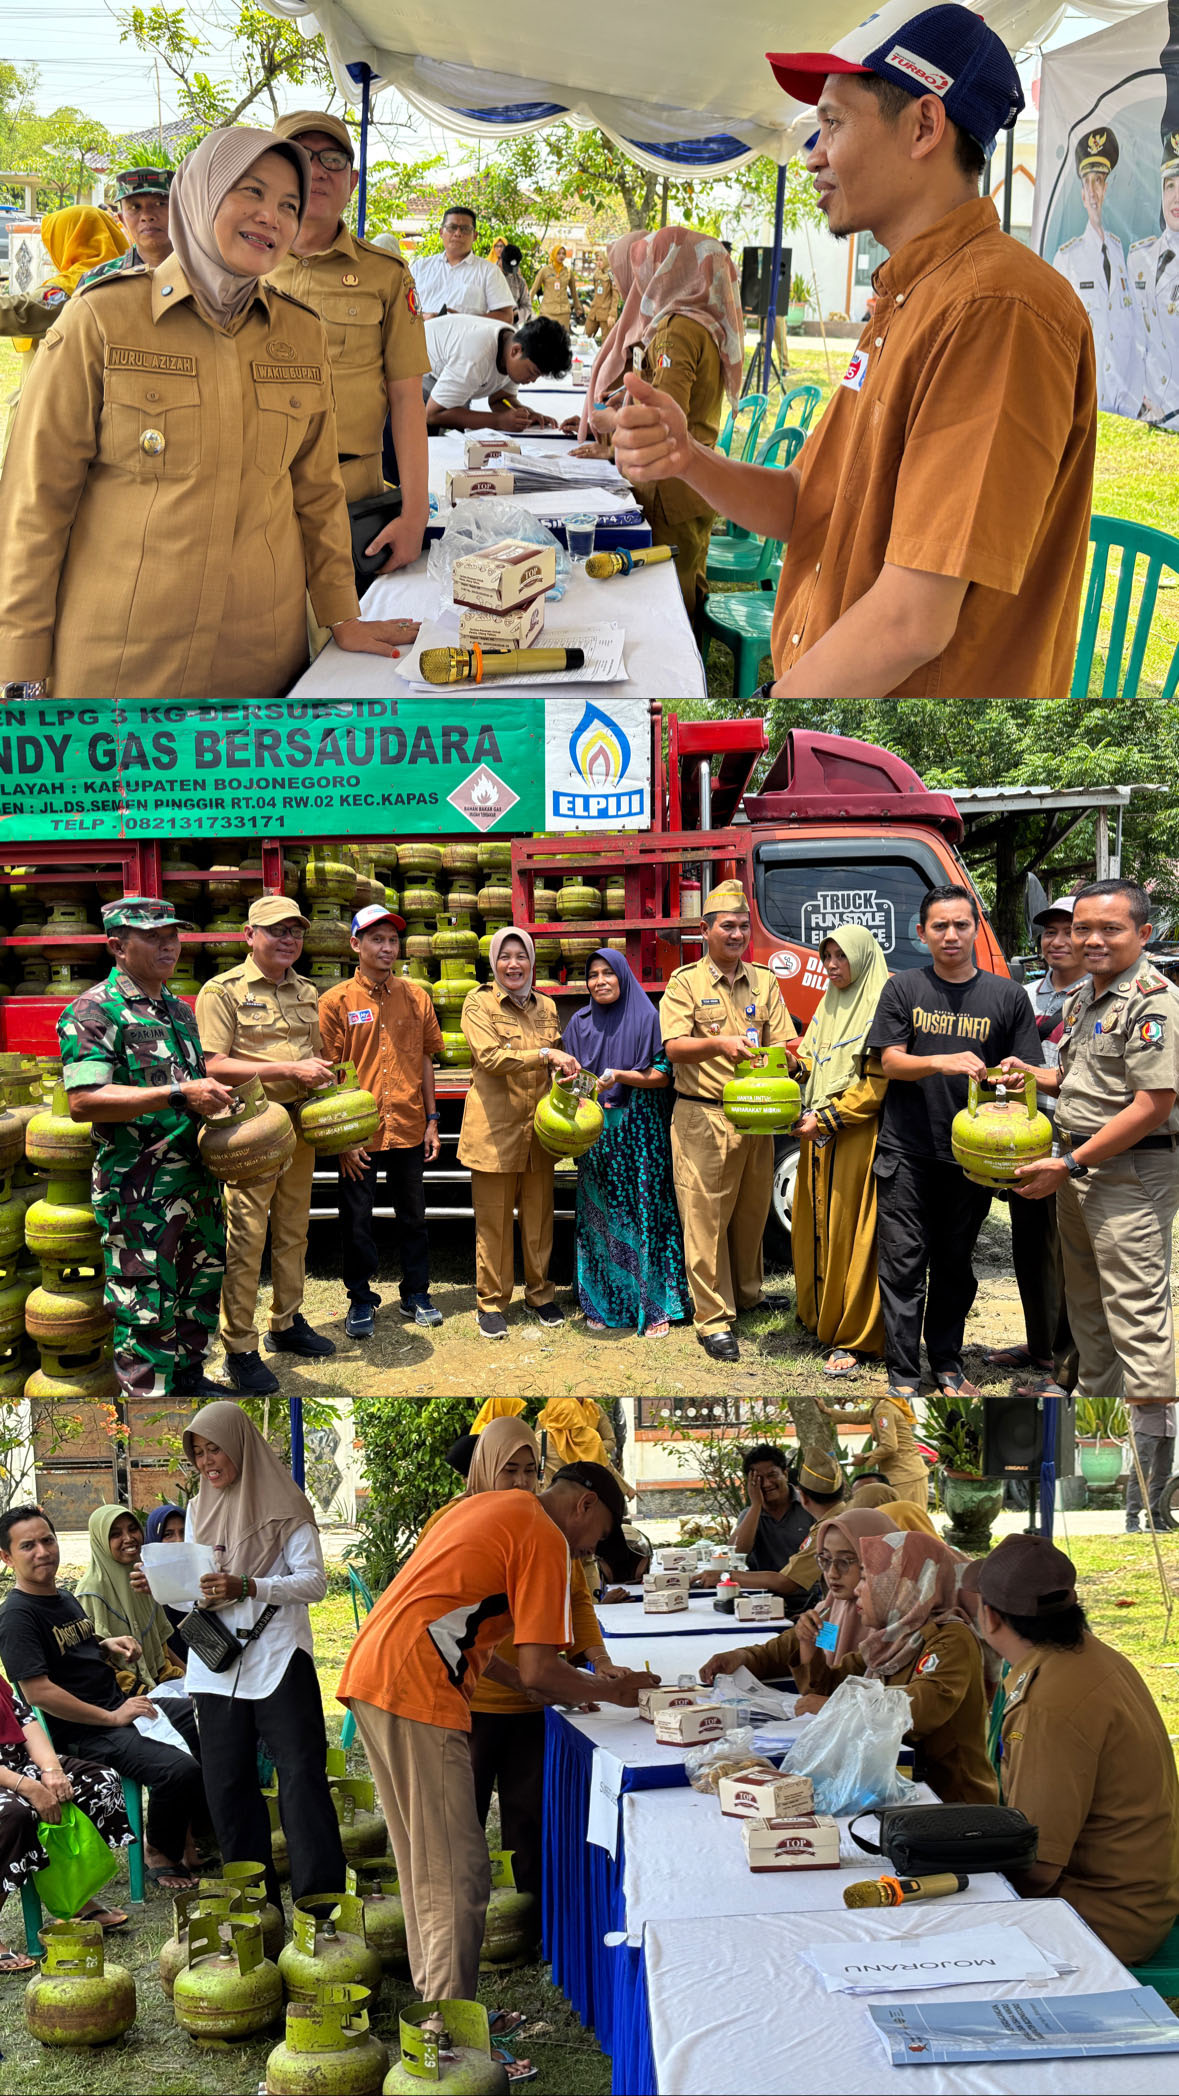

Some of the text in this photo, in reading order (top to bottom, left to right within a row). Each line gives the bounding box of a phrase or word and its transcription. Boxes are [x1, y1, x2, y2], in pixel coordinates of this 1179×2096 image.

[890, 55, 937, 85] TURBO
[111, 350, 192, 372] NURUL AZIZAH
[257, 366, 320, 380] WAKIL BUPATI
[38, 709, 99, 726] LPG
[110, 708, 128, 725] 3
[140, 707, 186, 724] KG
[88, 731, 178, 772] GAS
[194, 724, 503, 770] BERSAUDARA
[84, 778, 206, 795] KABUPATEN
[214, 775, 361, 791] BOJONEGORO
[154, 798, 226, 812] PINGGIR
[231, 796, 276, 810] RT.04
[283, 795, 334, 809] RW.02
[340, 792, 439, 807] KEC.KAPAS
[558, 793, 641, 816] ELPIJI
[50, 818, 105, 832] TELP
[125, 815, 285, 831] 082131733171
[818, 891, 876, 912] TRUCK
[811, 913, 840, 928] FUN
[842, 912, 886, 926] STYLE
[130, 1028, 165, 1039] PARJAN
[912, 1006, 991, 1043] PUSAT INFO
[739, 1792, 753, 1801] TOP
[784, 1839, 807, 1848] TOP
[844, 1958, 997, 1973] MOJORANU
